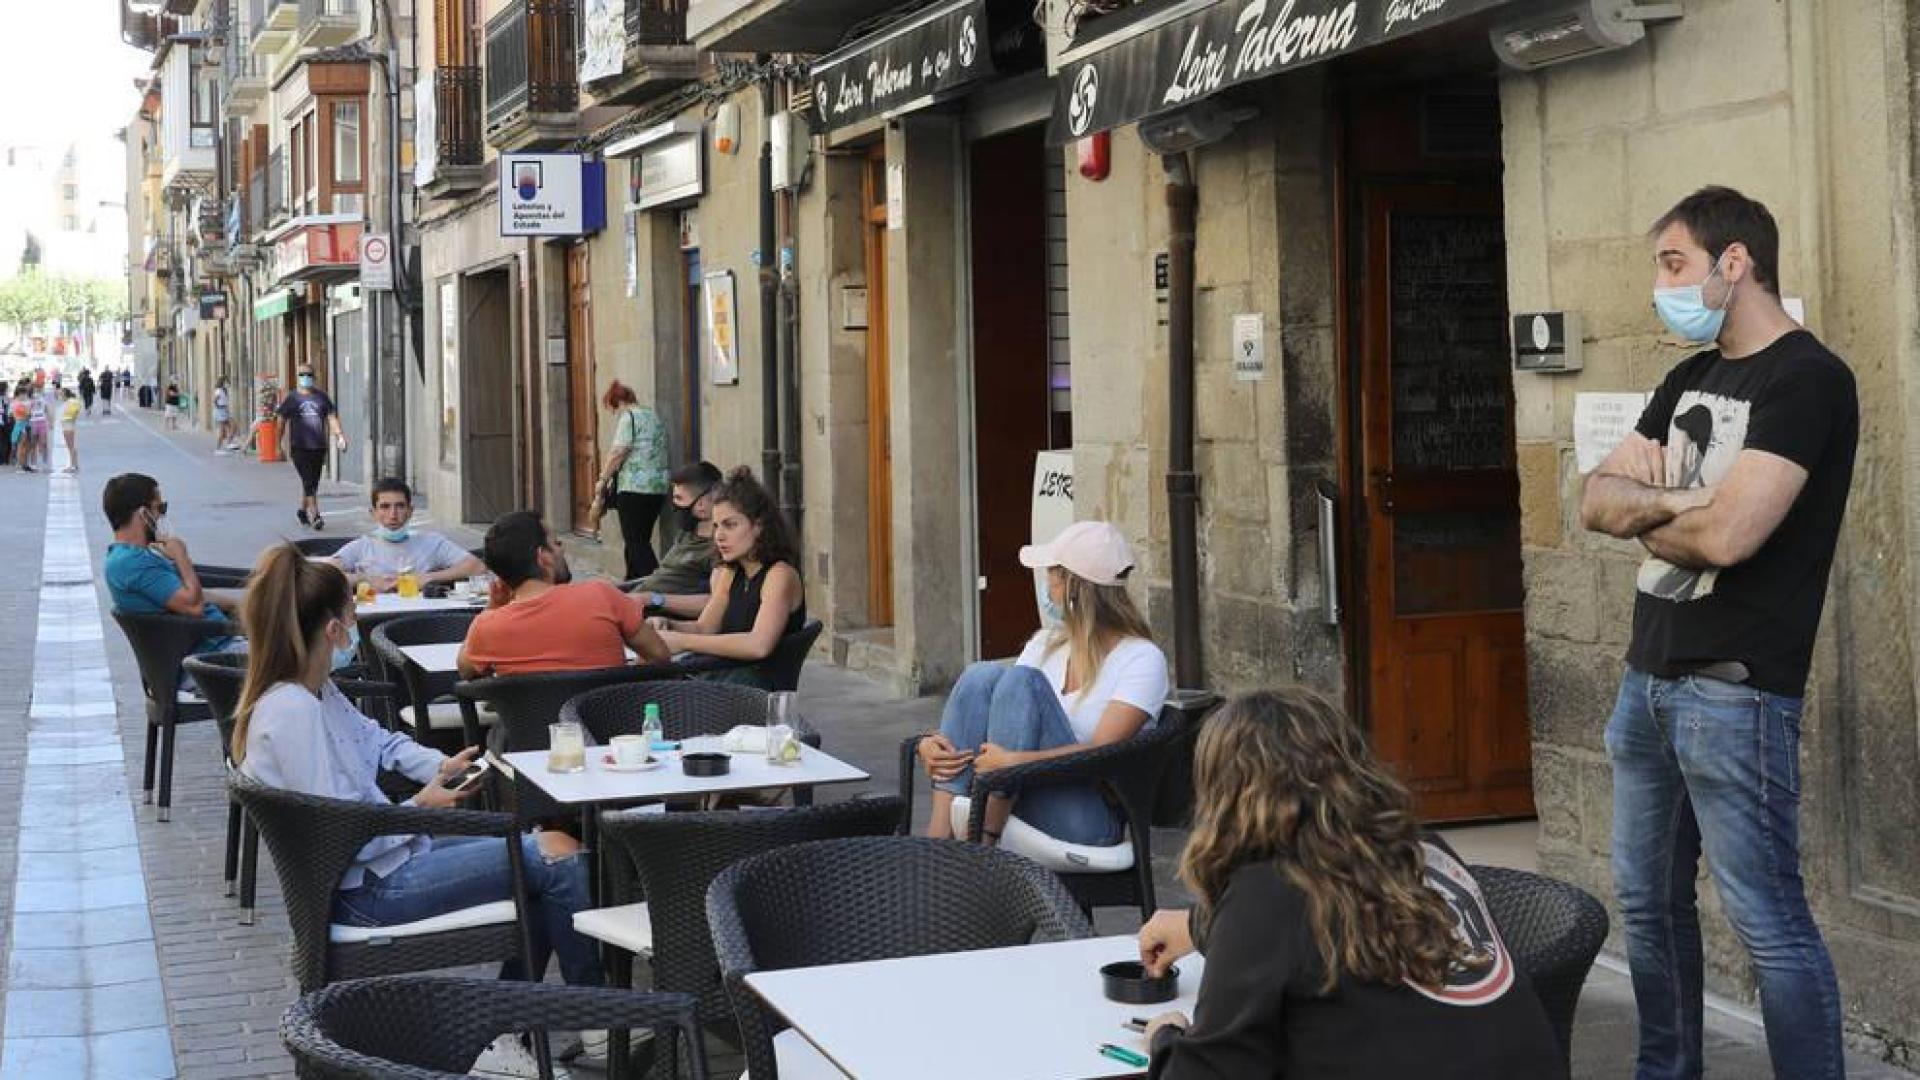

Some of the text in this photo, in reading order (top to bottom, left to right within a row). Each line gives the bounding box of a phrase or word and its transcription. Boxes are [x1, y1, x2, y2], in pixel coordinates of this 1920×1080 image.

[867, 55, 913, 109] Taberna
[1163, 0, 1358, 104] Leire Taberna
